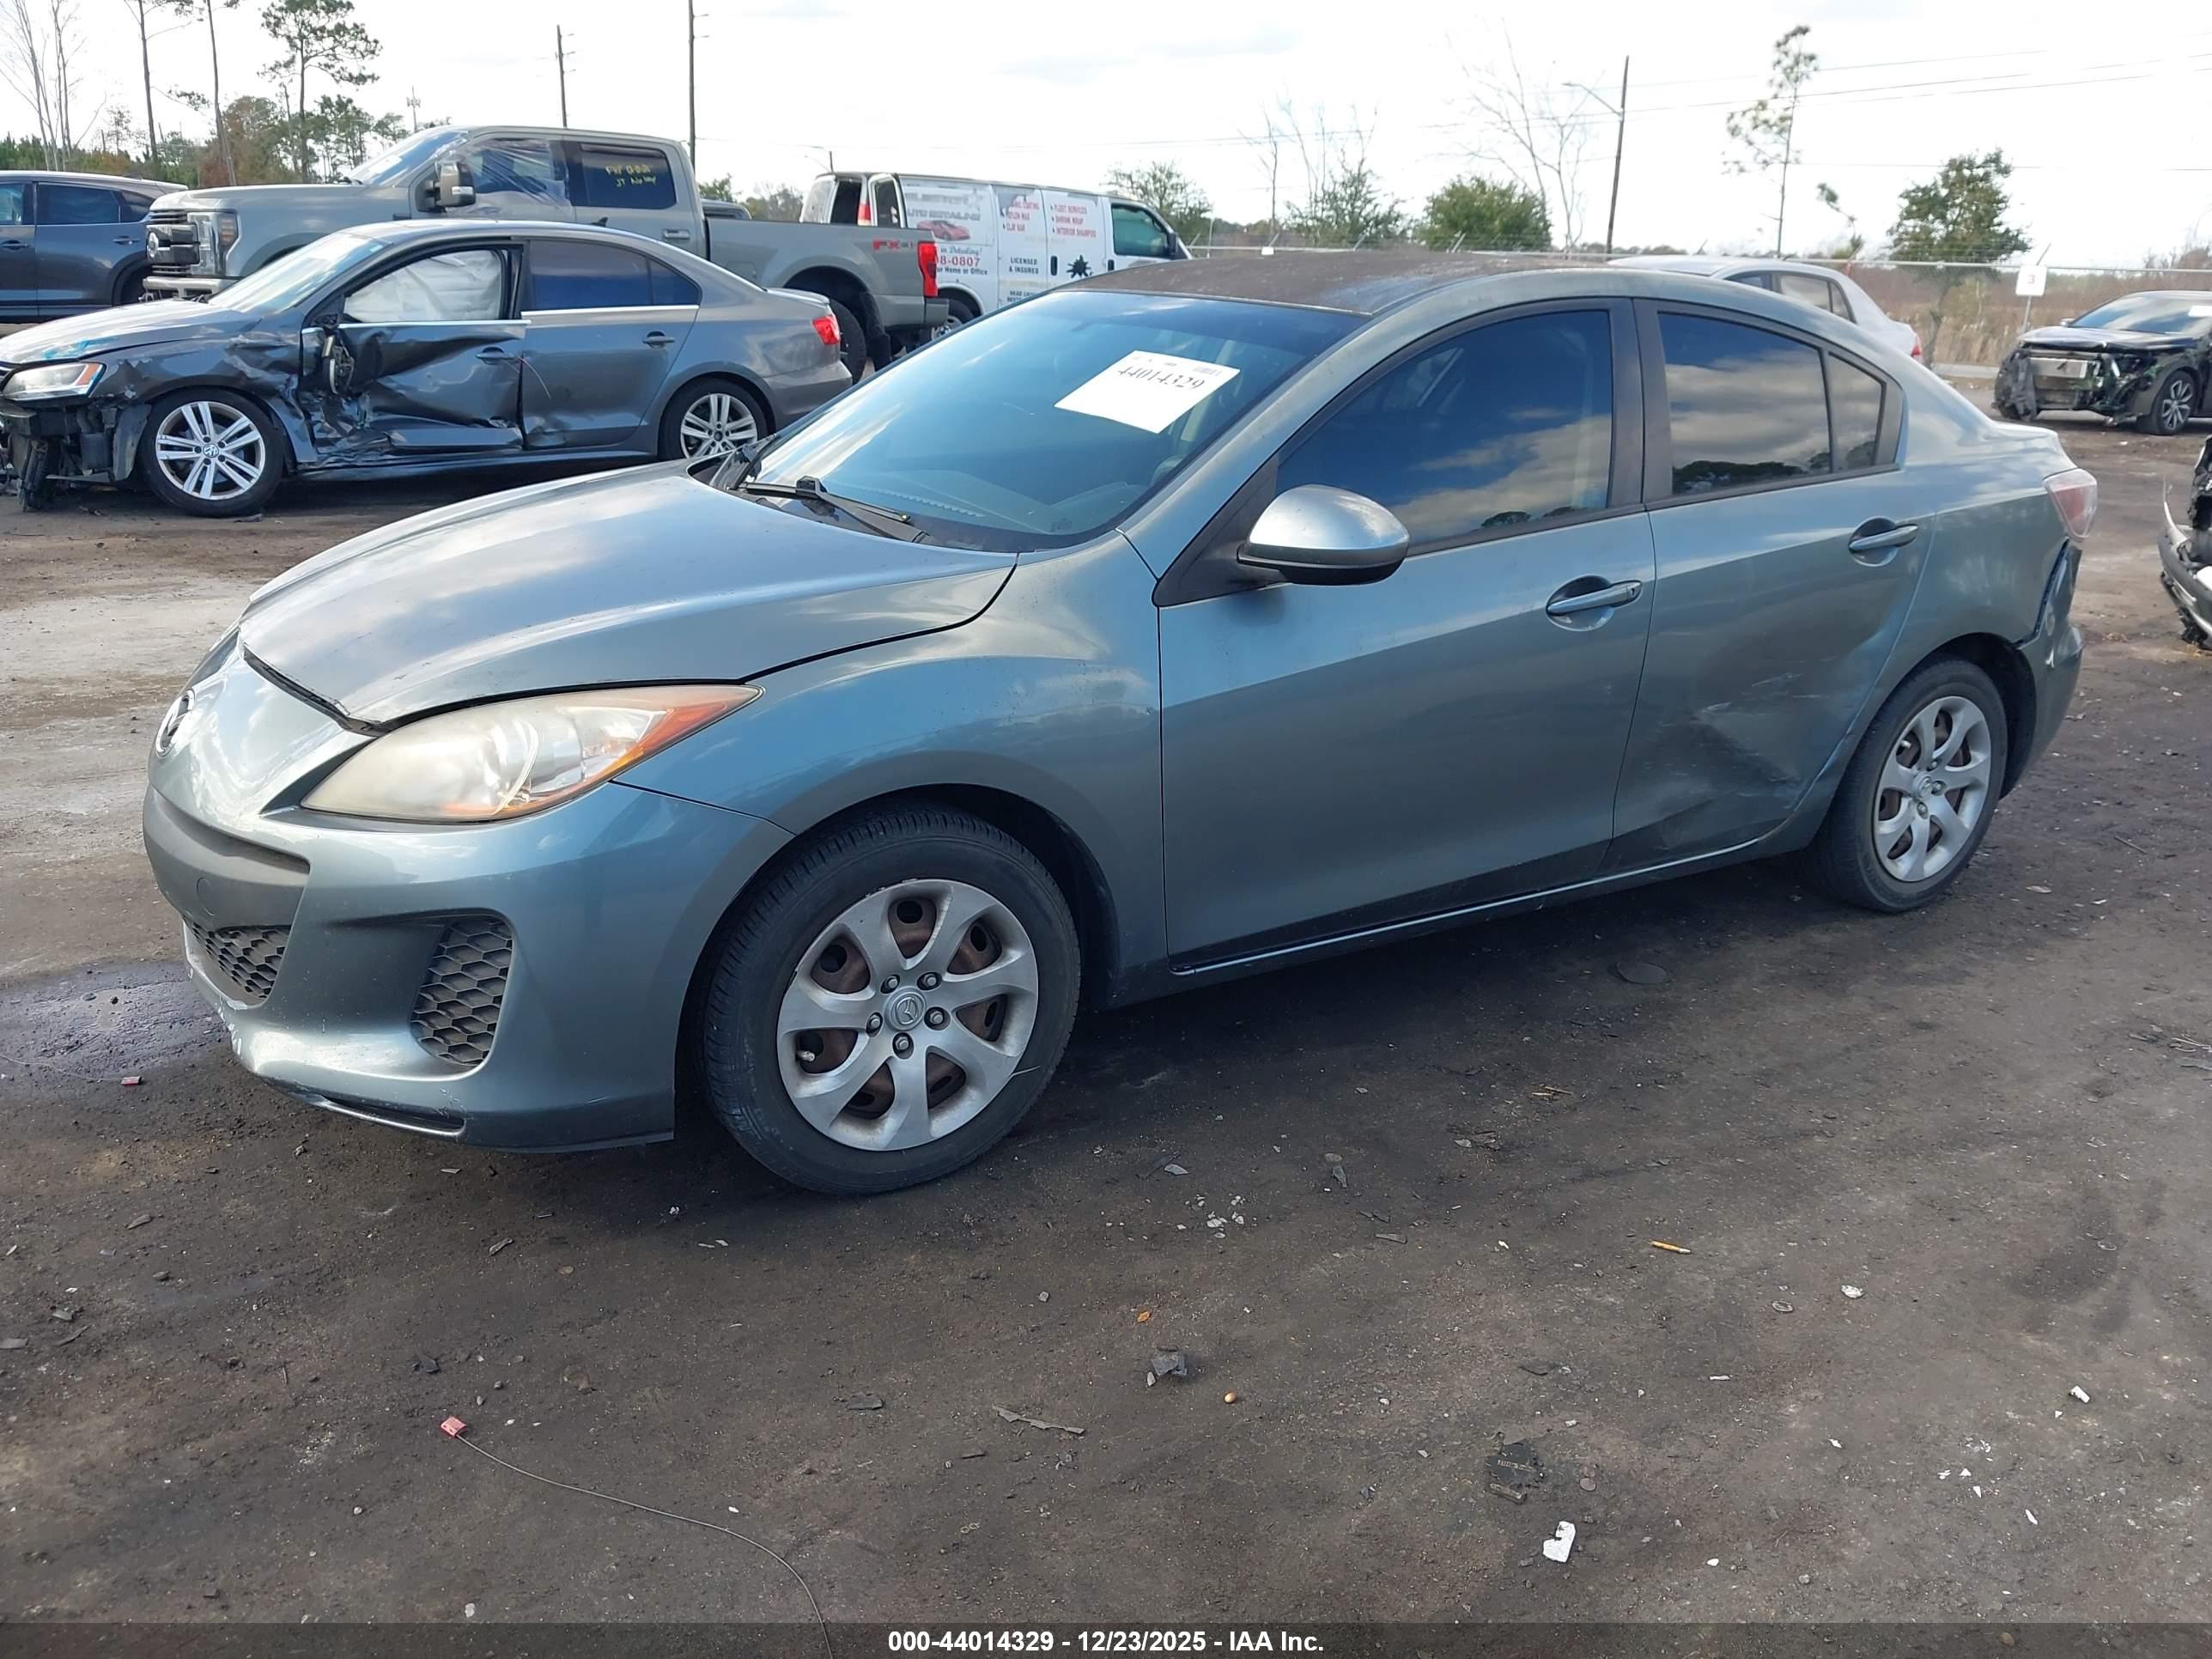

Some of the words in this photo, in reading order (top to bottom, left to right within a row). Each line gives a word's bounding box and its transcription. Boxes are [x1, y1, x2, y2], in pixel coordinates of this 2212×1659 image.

[1067, 205, 1087, 215] SERVICES
[1056, 227, 1076, 235] INTERIOR
[1076, 228, 1097, 238] SHAMPOO
[1010, 257, 1038, 265] LICENSED
[1118, 366, 1206, 389] 44014329
